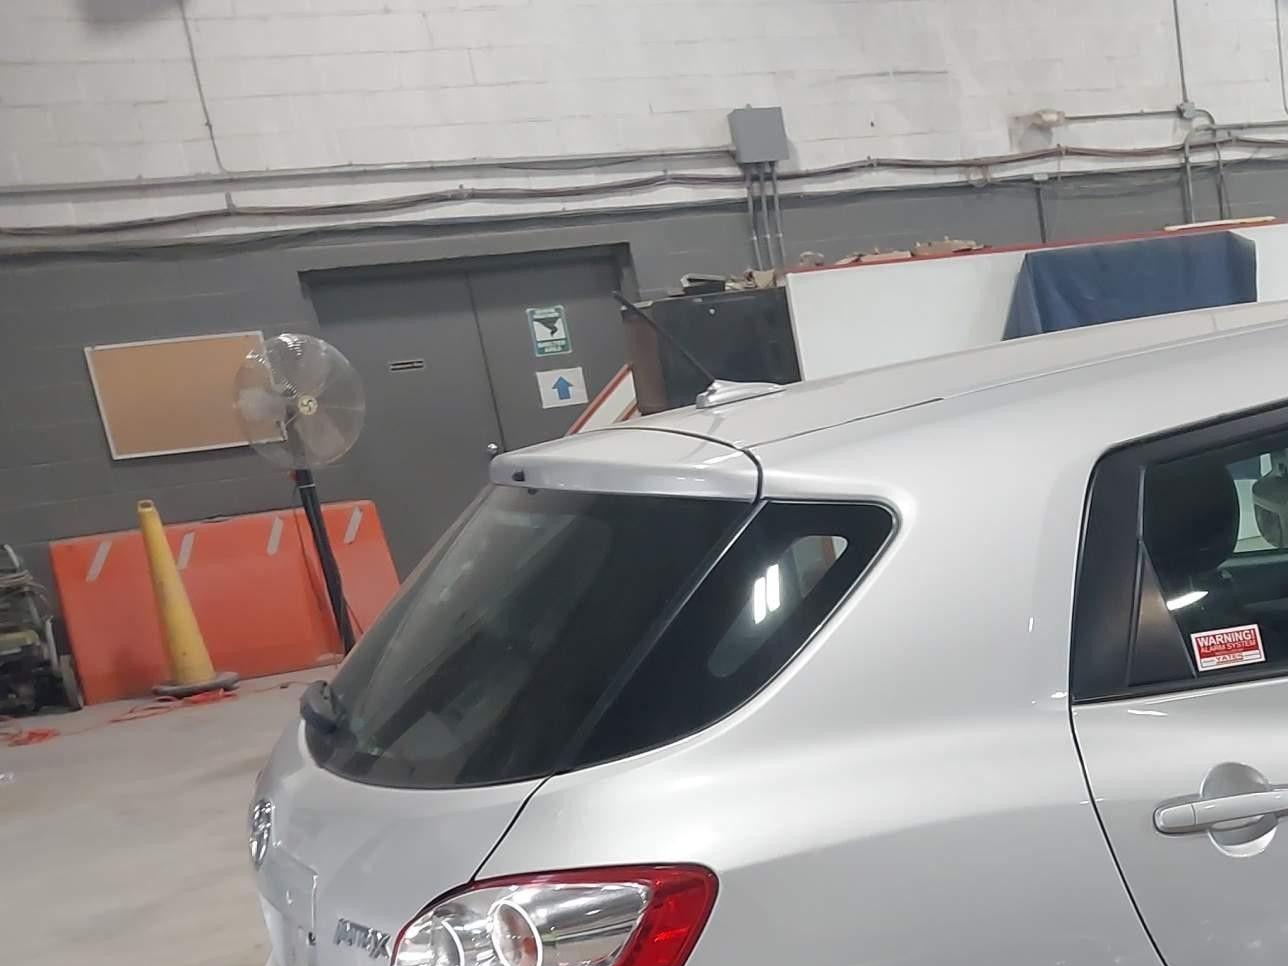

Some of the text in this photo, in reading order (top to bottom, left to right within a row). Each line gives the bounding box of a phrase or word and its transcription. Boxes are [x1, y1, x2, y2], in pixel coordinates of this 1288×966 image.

[1197, 628, 1256, 647] WARNING!
[1200, 639, 1257, 653] ALARM SYSTEM
